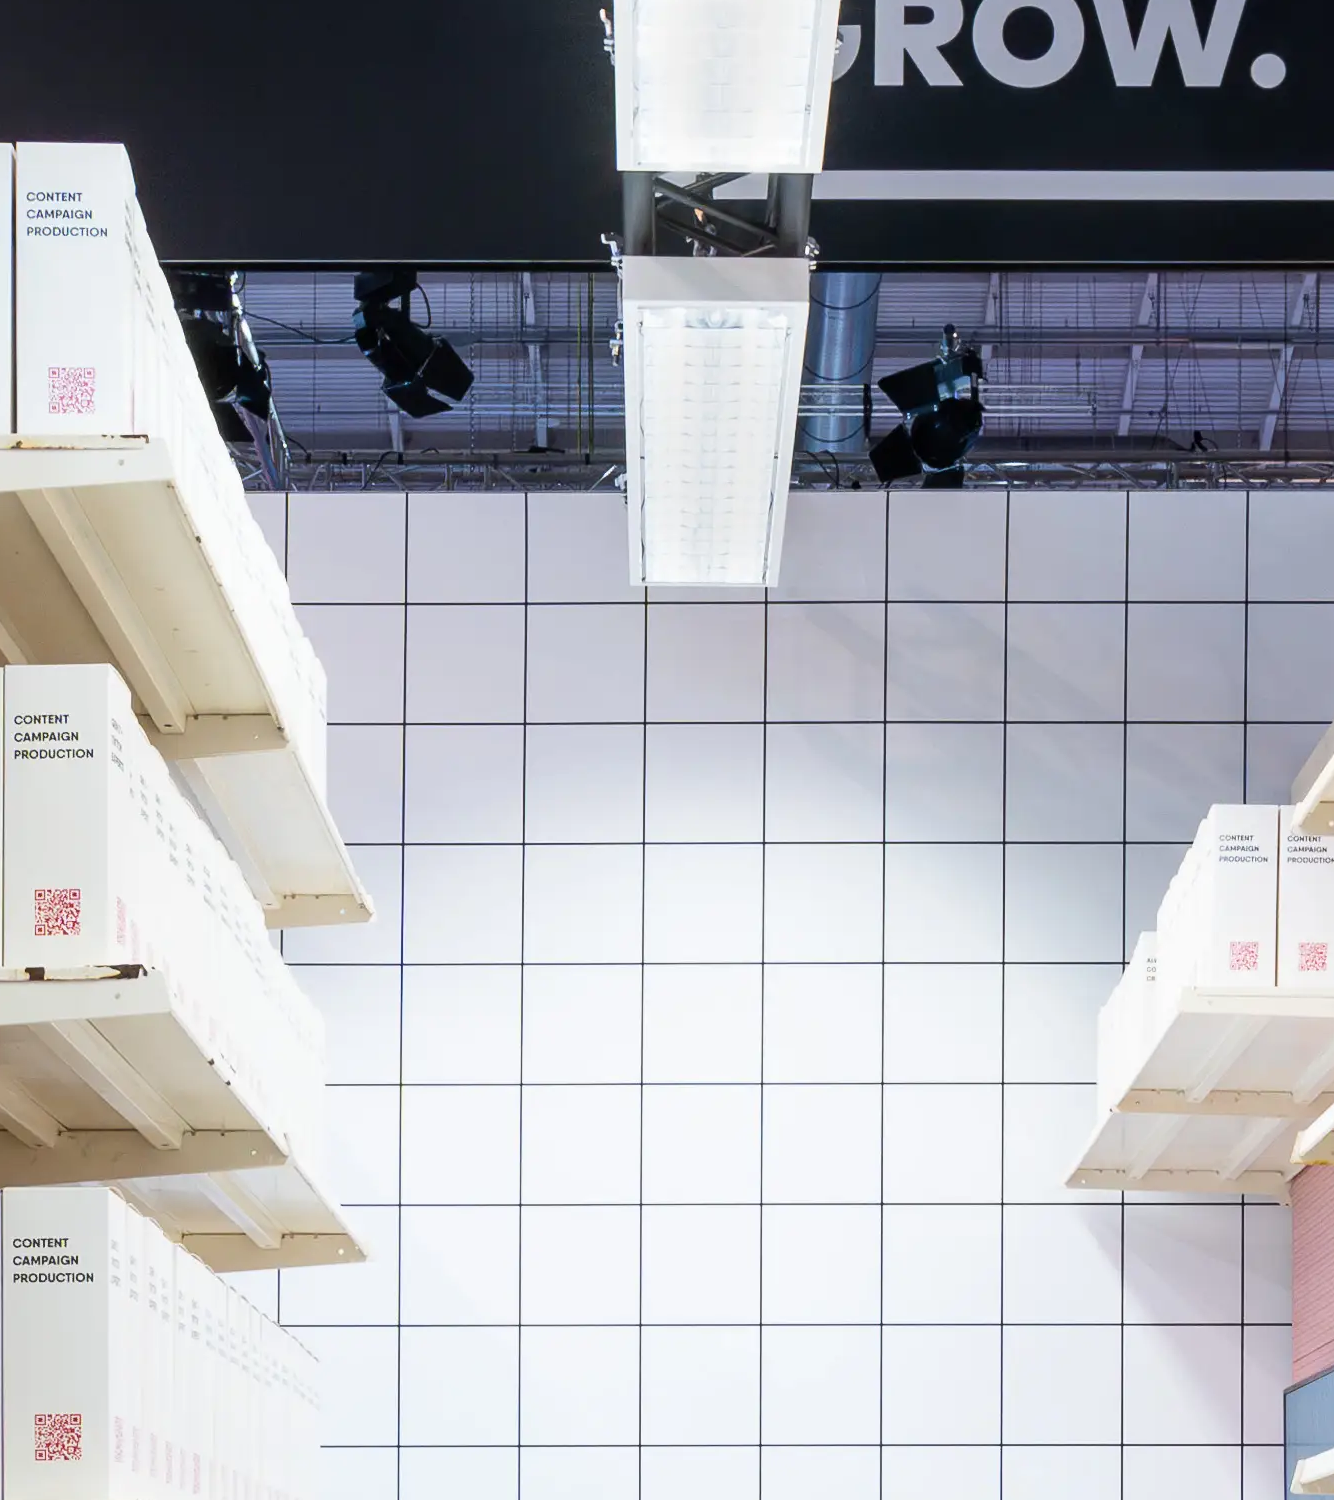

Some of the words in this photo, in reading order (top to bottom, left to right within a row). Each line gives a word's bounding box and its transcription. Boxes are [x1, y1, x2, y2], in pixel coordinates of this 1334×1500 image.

[26, 191, 82, 202] CONTENT
[26, 209, 92, 219] CAMPAIGN
[26, 226, 107, 237] PRODUCTION
[13, 714, 69, 725] CONTENT
[13, 731, 78, 742] CAMPAIGN
[14, 748, 93, 759] PRODUCTION
[1219, 844, 1259, 852] CAMPAIGN
[12, 1237, 69, 1248] CONTENT
[12, 1254, 78, 1266] CAMPAIGN
[13, 1272, 93, 1283] PRODUCTION
